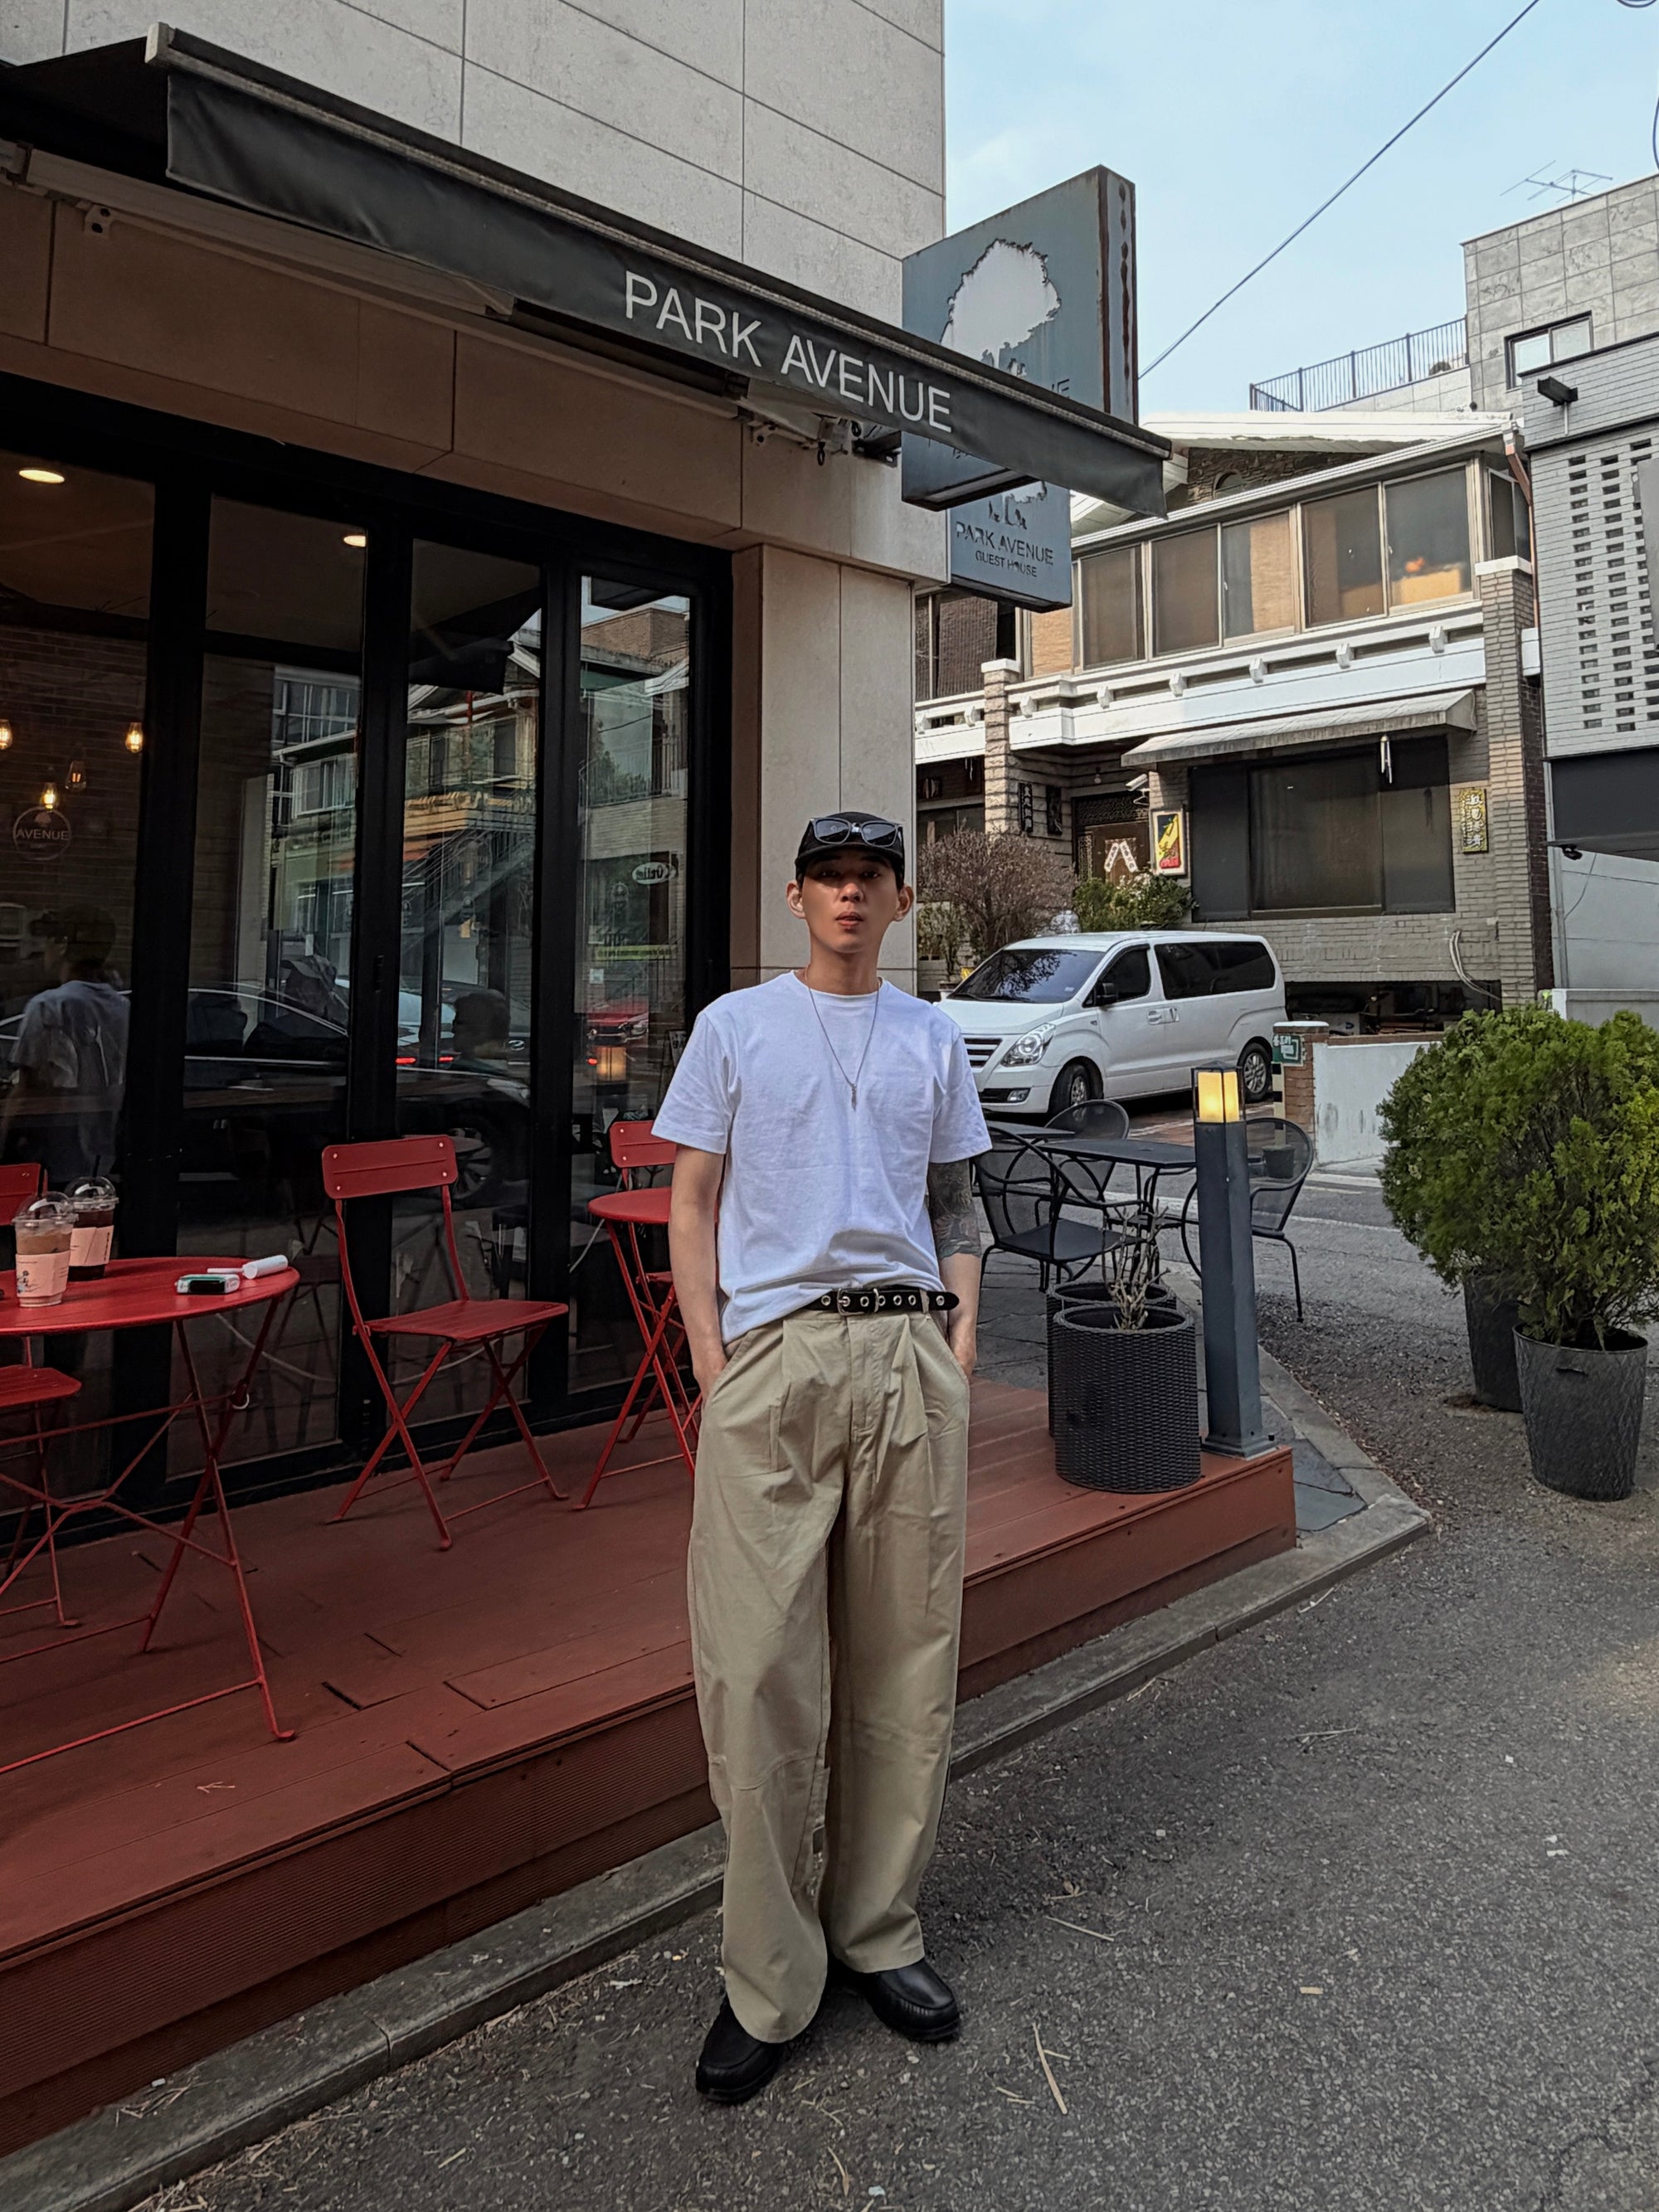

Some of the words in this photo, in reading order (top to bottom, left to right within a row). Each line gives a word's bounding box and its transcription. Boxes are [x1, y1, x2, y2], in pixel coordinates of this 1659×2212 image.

[625, 270, 761, 367] PARK
[781, 335, 952, 433] AVENUE
[956, 521, 995, 549] PARK
[998, 535, 1053, 566] AVENUE
[975, 550, 1005, 568] GUEST
[1007, 559, 1038, 577] HOUSE
[17, 829, 70, 840] AVENUE
